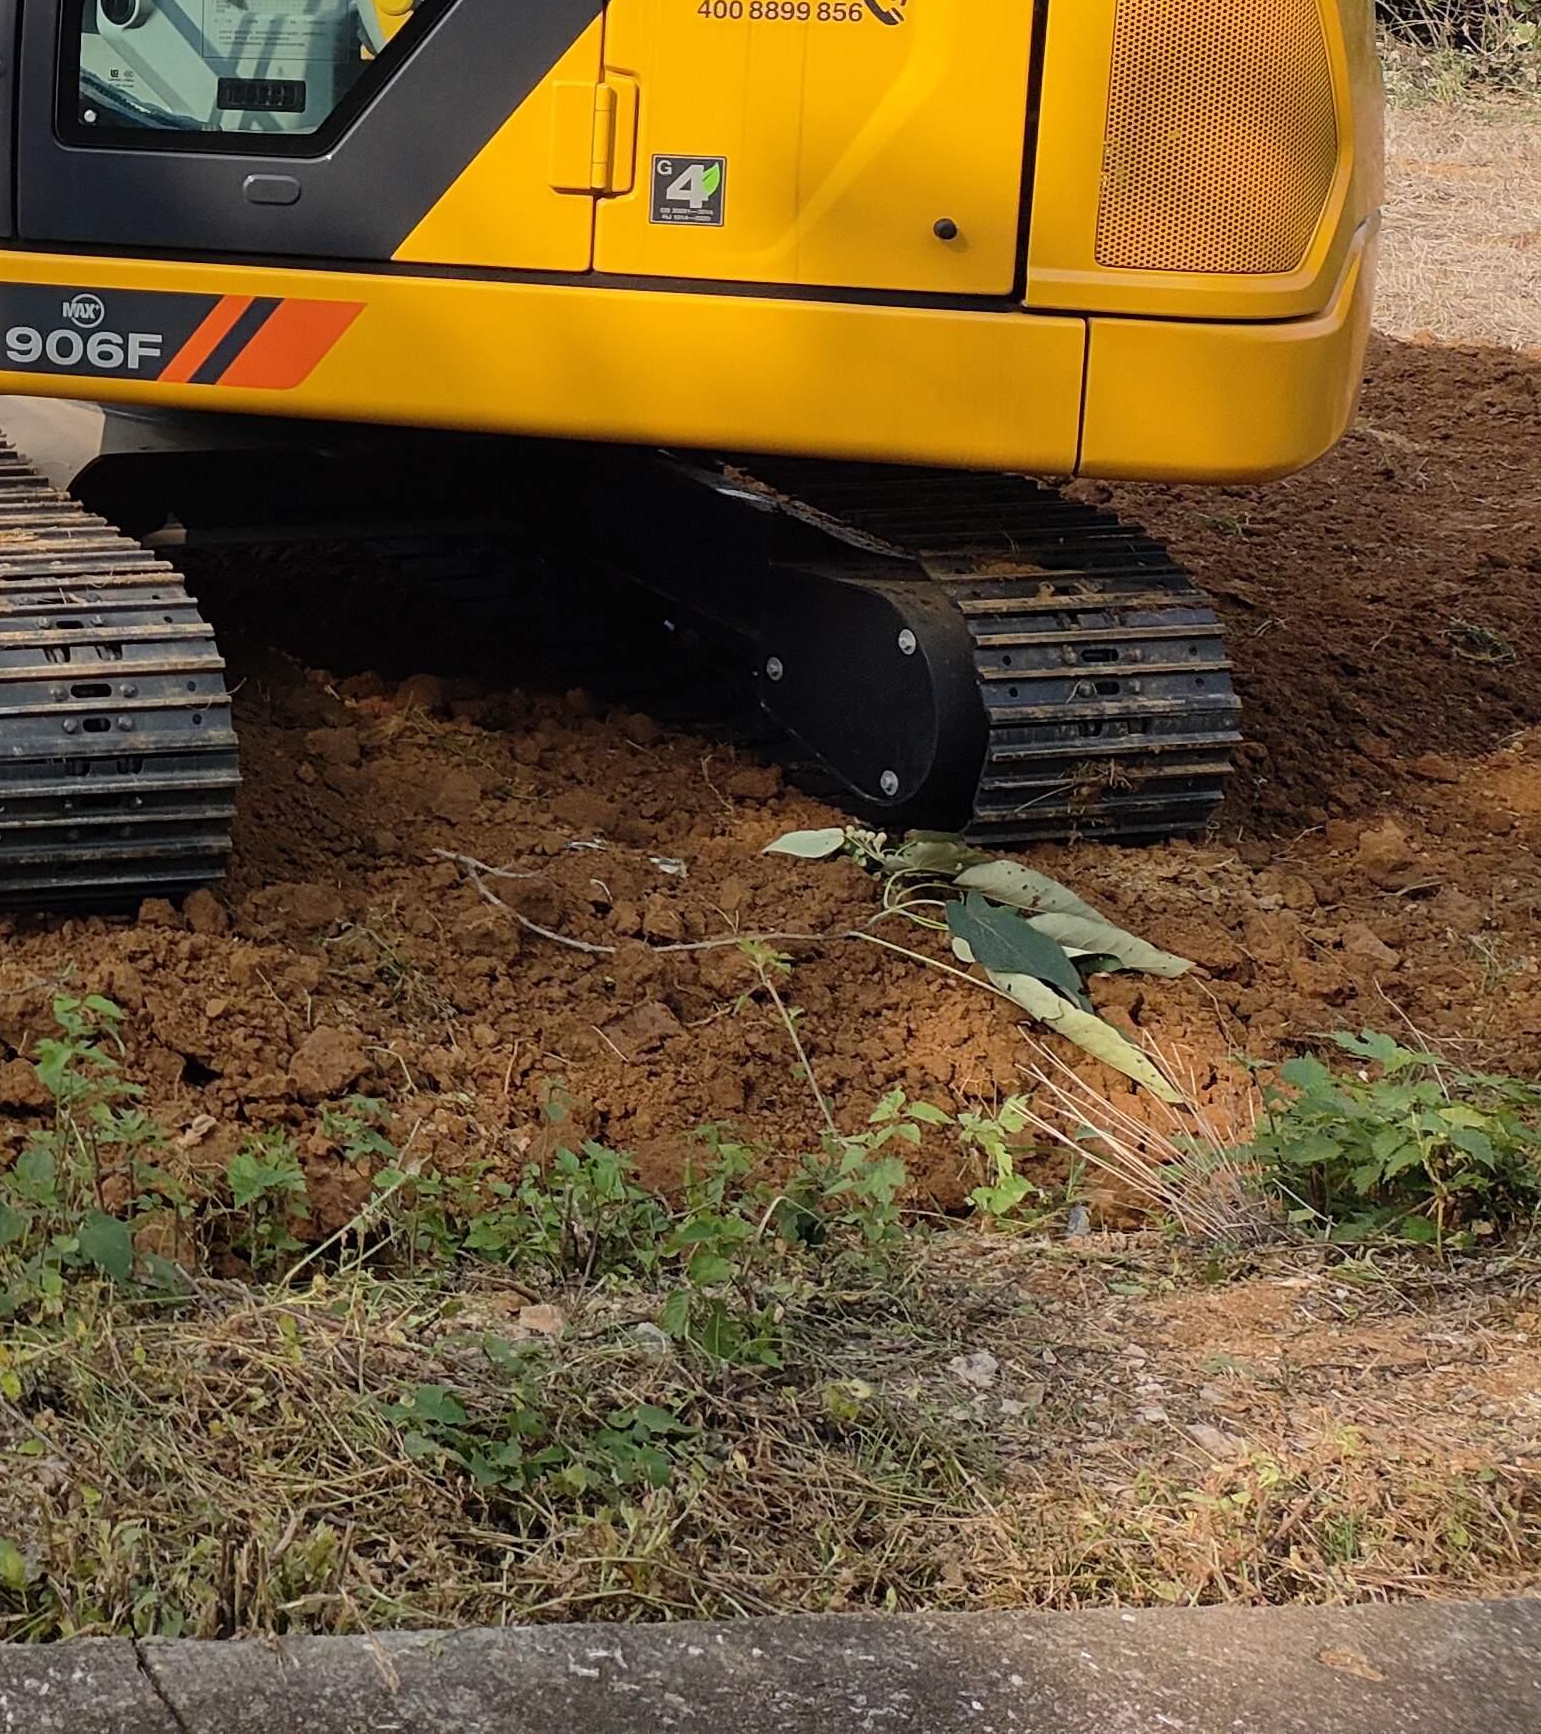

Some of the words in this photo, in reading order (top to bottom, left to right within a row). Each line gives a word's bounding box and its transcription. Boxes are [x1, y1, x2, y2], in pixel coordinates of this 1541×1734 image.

[697, 0, 743, 20] 400
[749, 1, 811, 21] 8899
[816, 2, 863, 22] 856
[657, 160, 672, 175] G
[666, 164, 709, 208] 4
[5, 327, 164, 369] 906F
